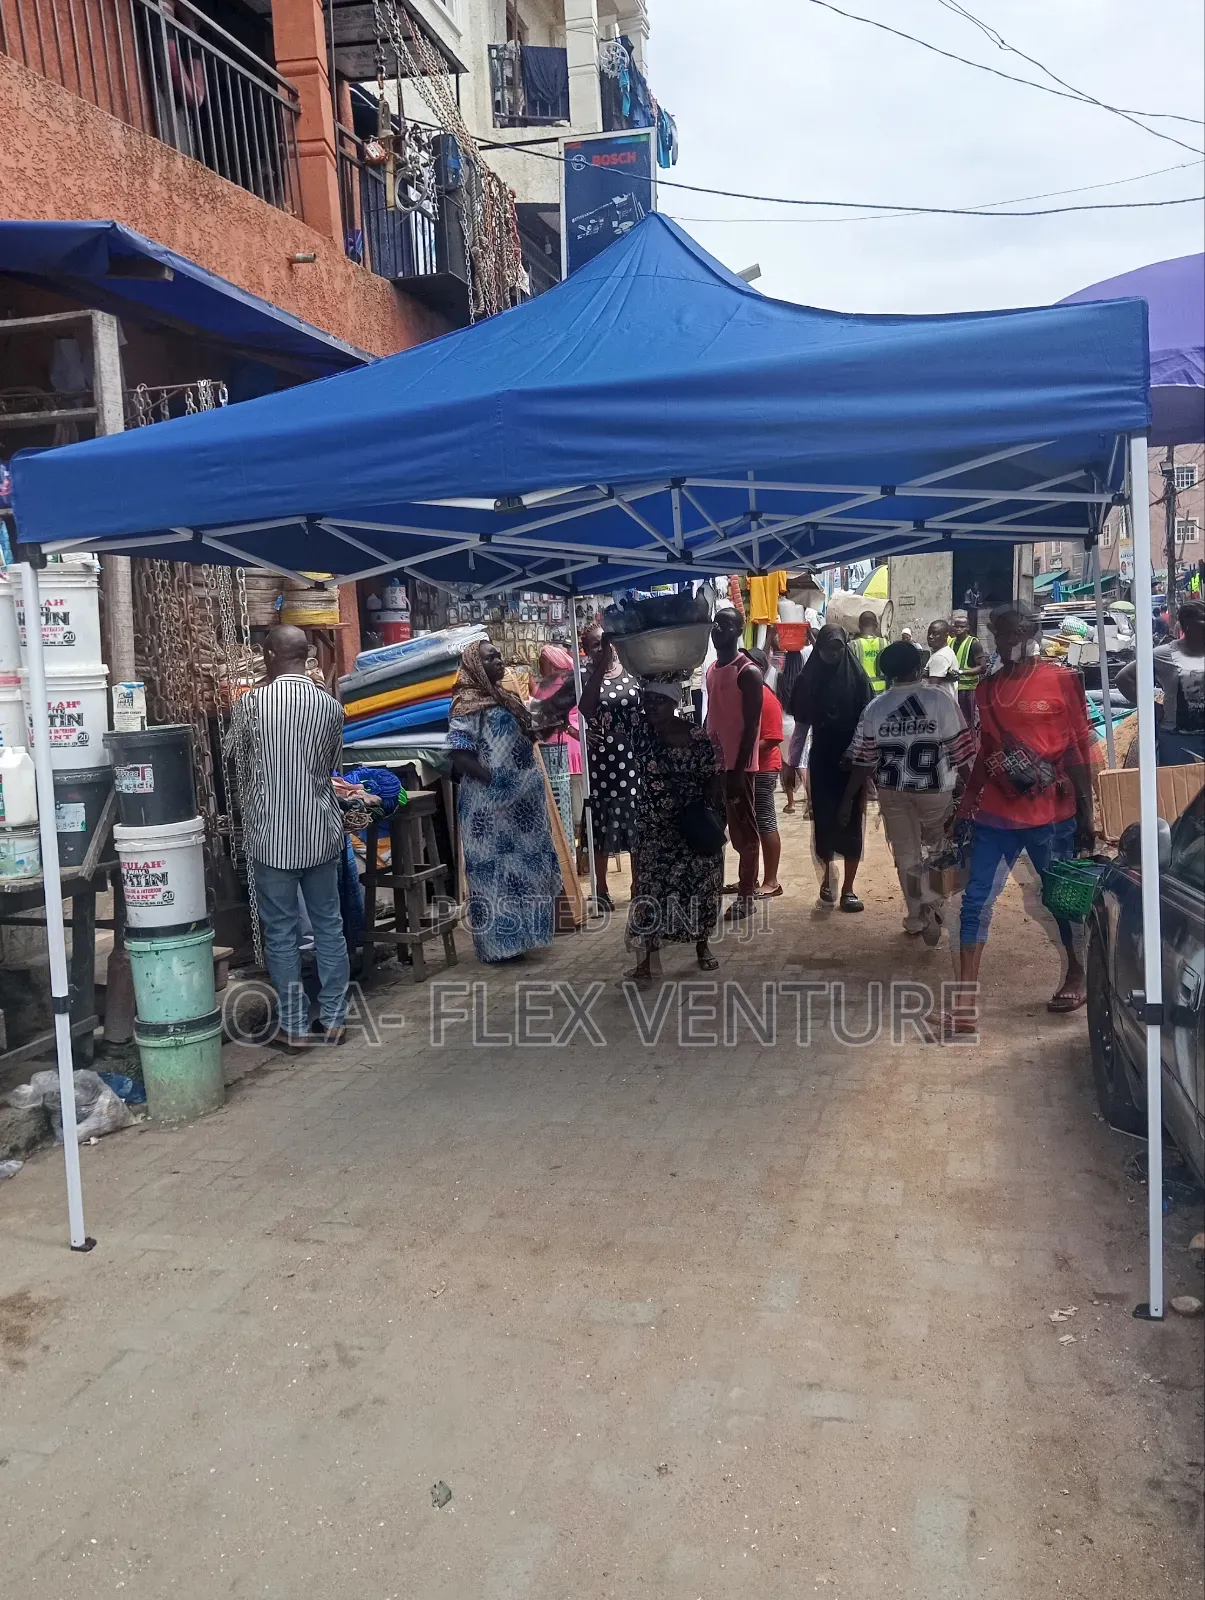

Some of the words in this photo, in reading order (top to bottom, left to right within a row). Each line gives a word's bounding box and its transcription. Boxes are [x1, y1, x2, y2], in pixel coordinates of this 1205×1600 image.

[592, 152, 637, 166] BOSCH
[64, 632, 75, 641] 20
[878, 718, 937, 737] adidas
[78, 733, 89, 742] 20
[163, 892, 174, 901] 20
